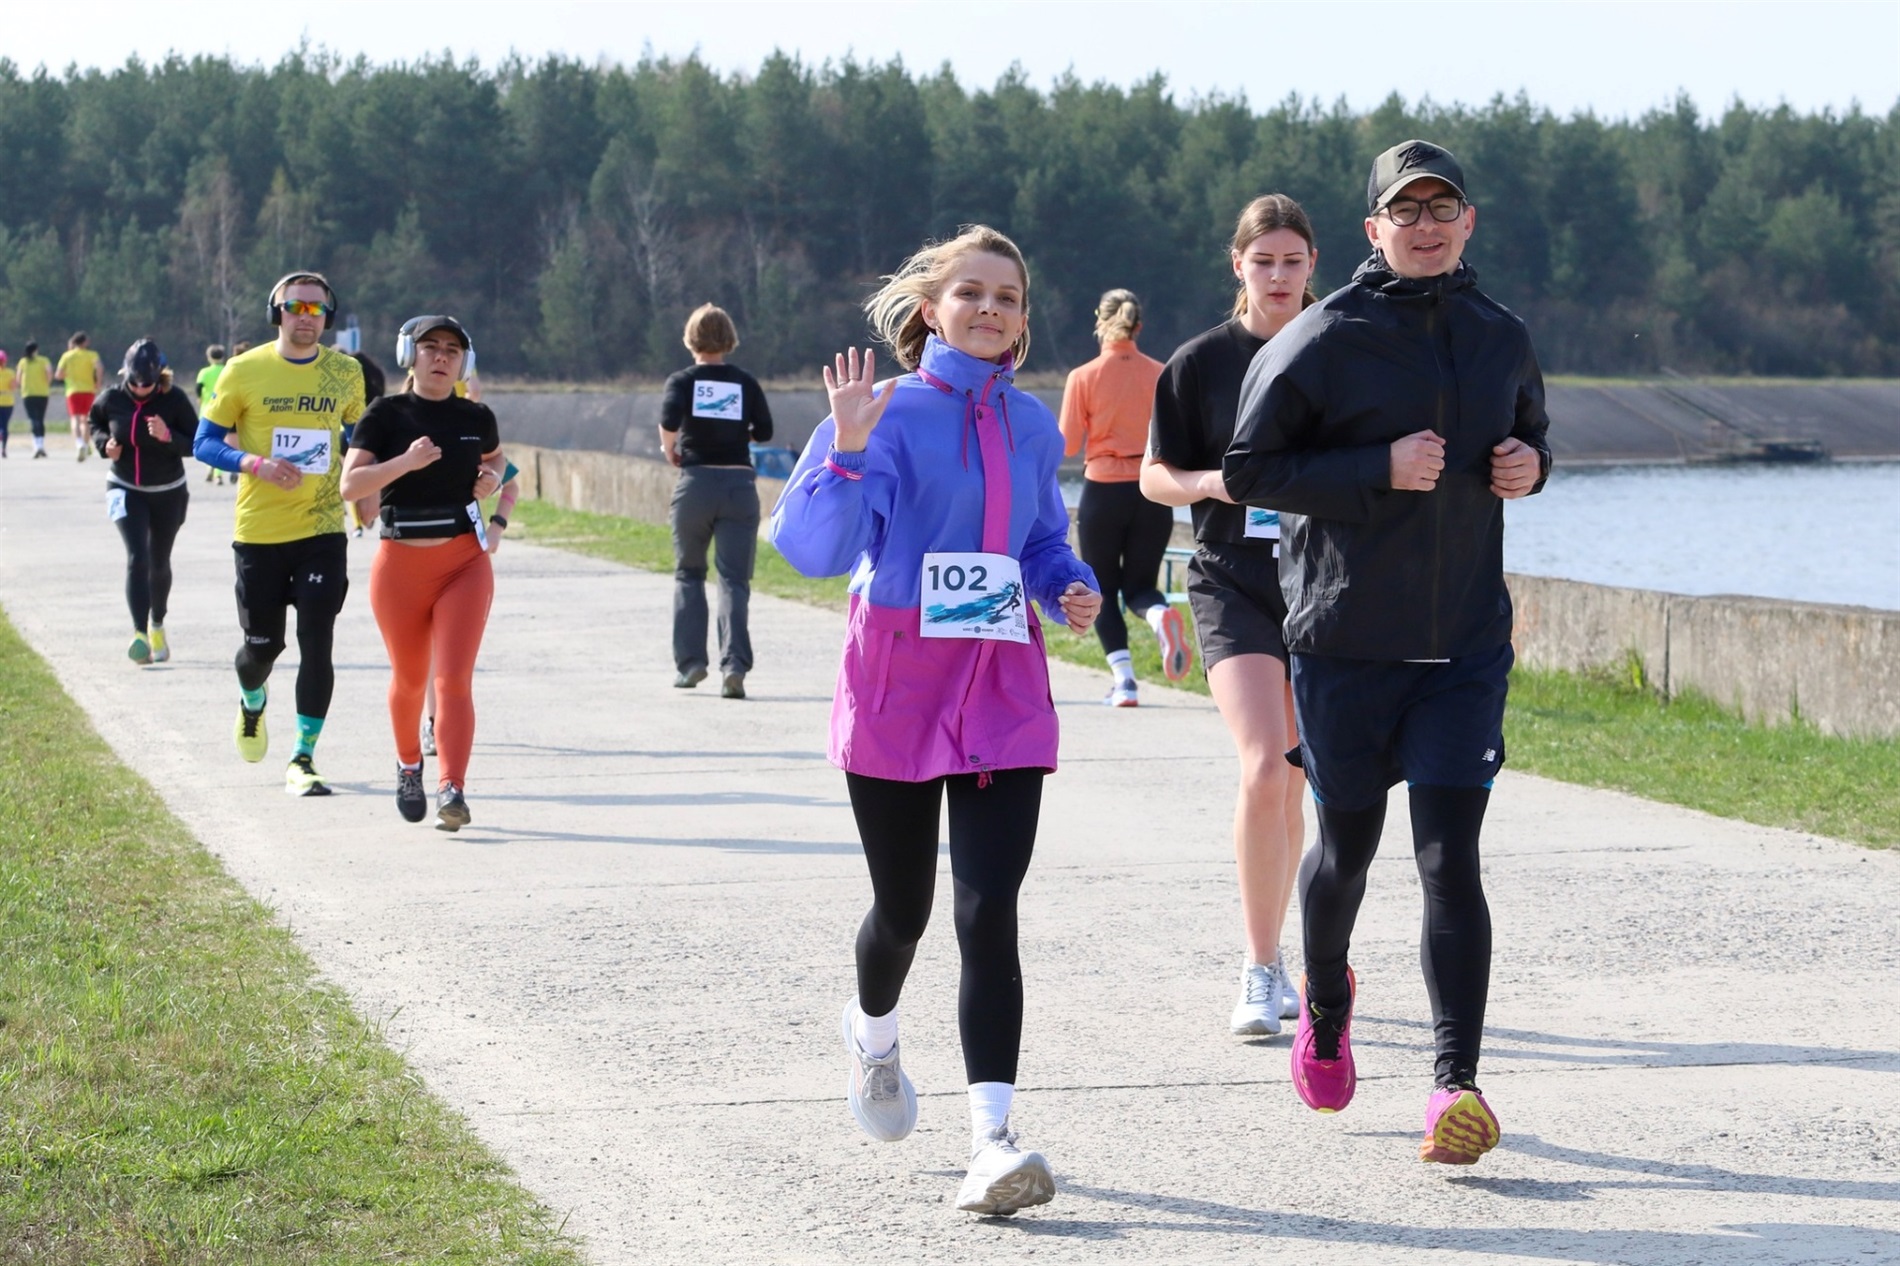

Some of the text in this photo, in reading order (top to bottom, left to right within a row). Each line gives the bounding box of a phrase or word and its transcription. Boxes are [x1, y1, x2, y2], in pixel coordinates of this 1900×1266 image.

[697, 386, 714, 398] 55
[263, 396, 294, 406] Energo
[298, 396, 337, 413] RUN
[269, 403, 293, 413] Atom
[276, 434, 301, 448] 117
[928, 565, 987, 591] 102
